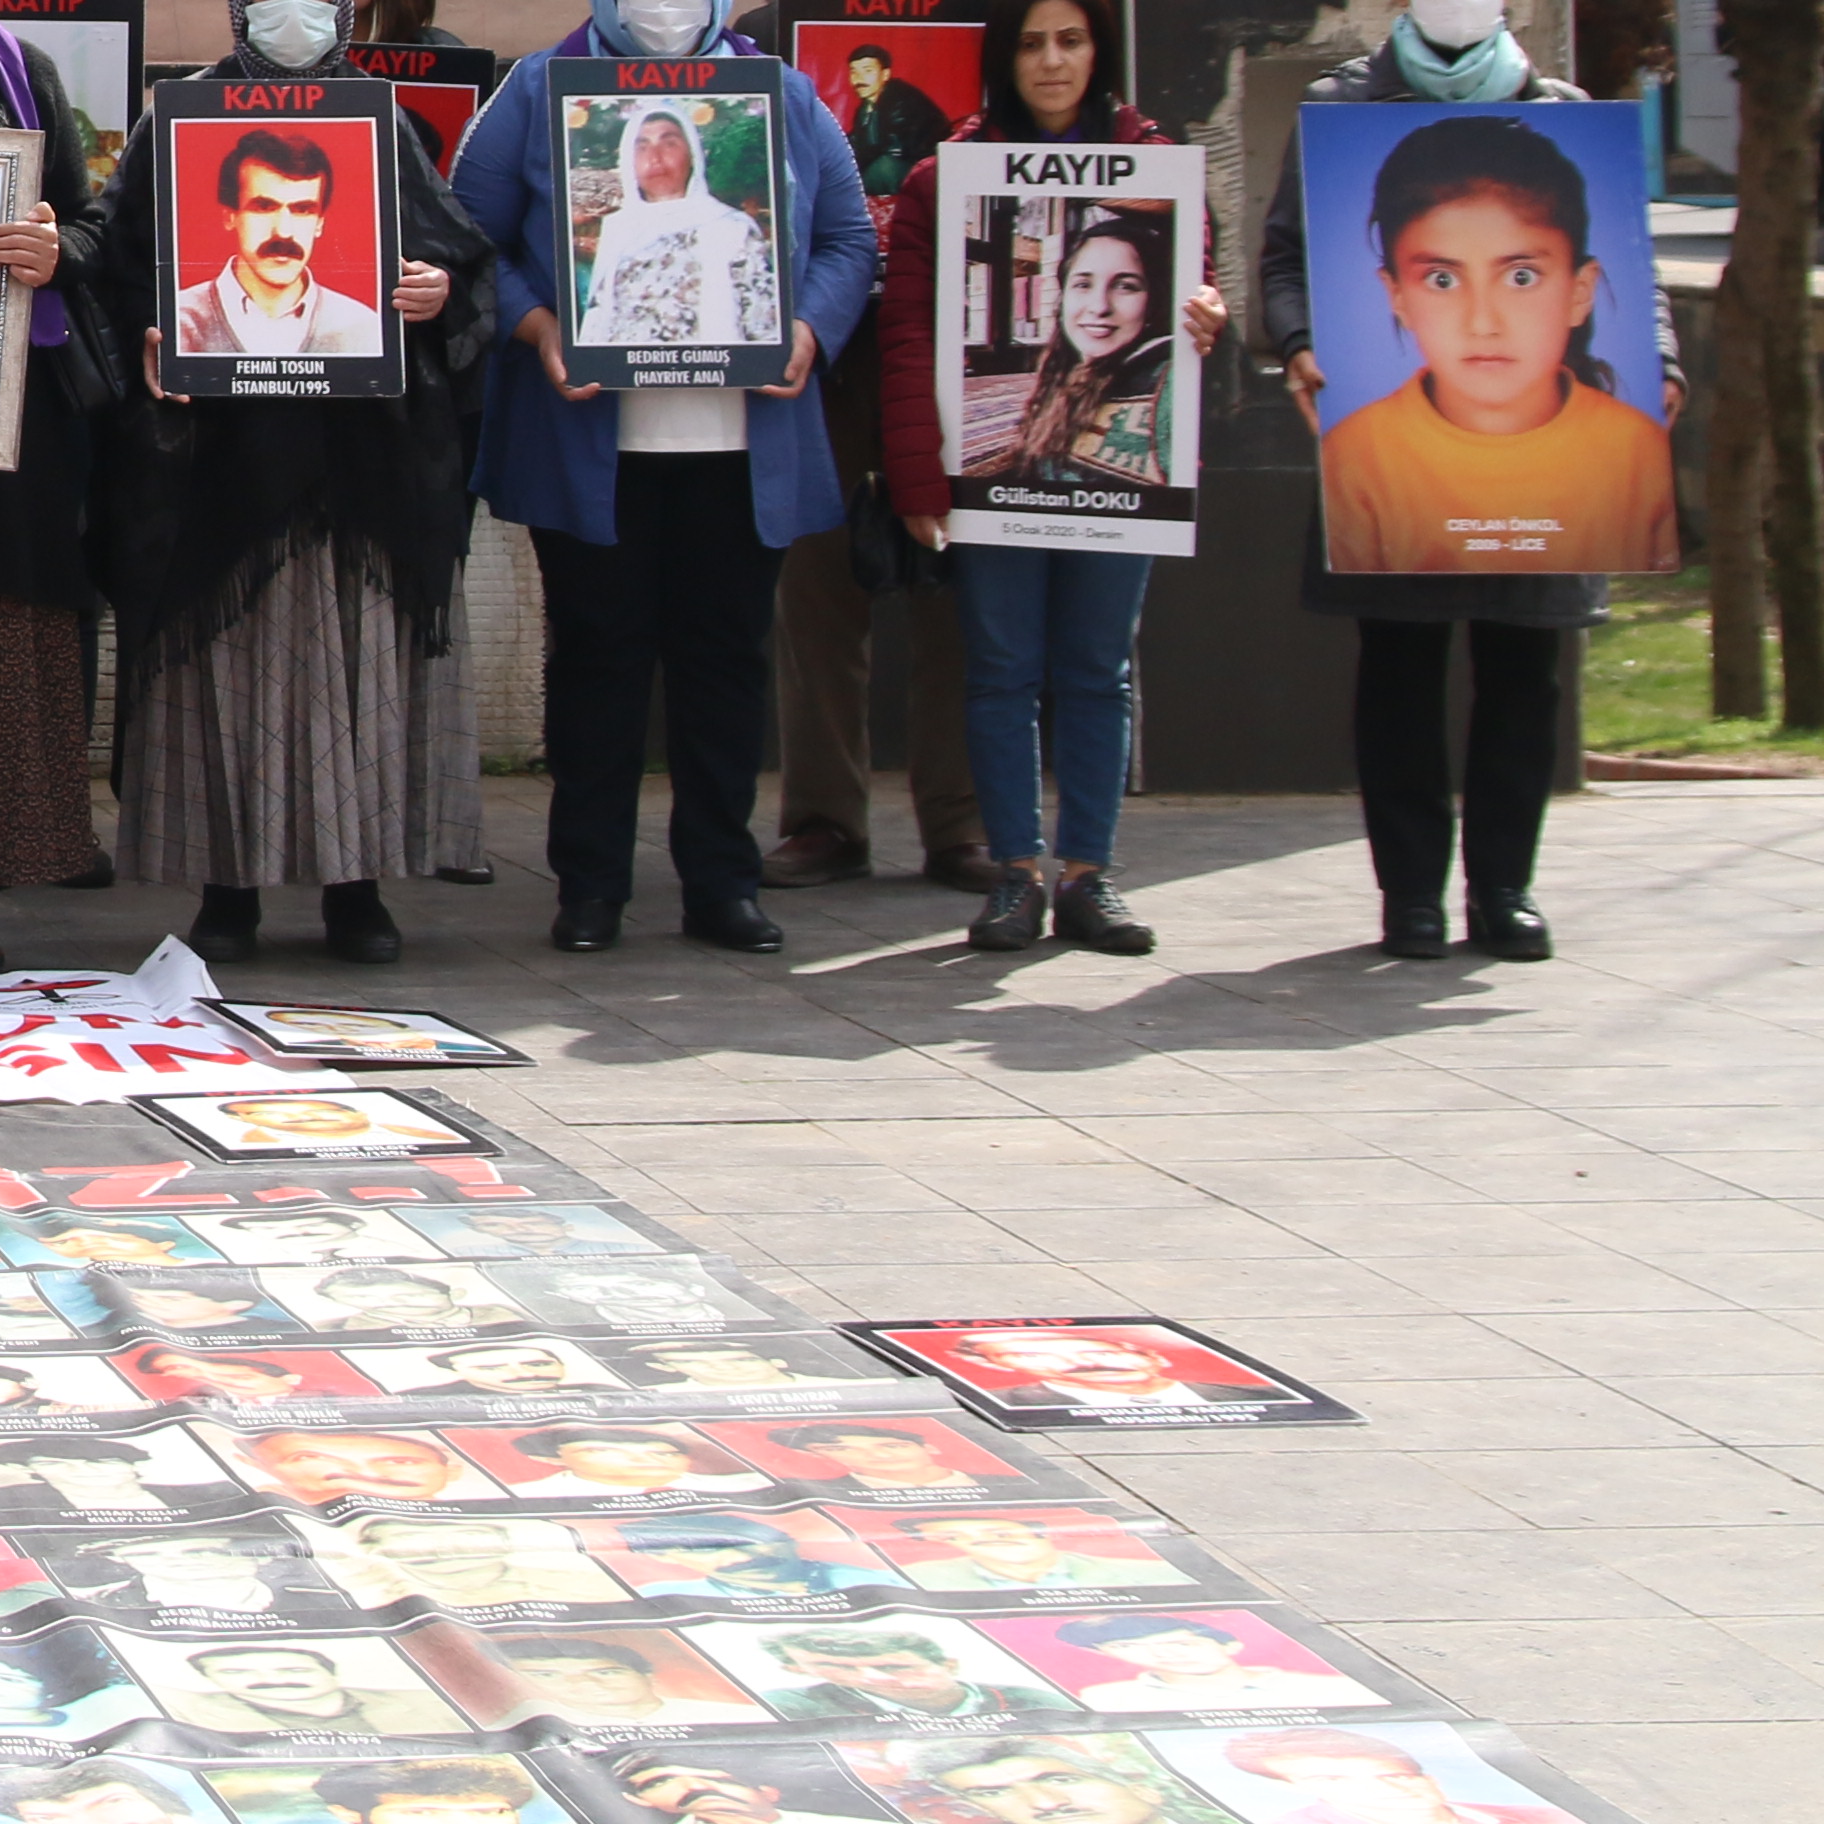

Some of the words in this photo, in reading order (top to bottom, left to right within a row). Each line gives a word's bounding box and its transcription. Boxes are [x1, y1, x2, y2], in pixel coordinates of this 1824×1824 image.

[615, 62, 716, 89] KAYIP
[224, 85, 326, 111] KAYIP
[1005, 152, 1137, 186] KAYIP
[236, 357, 278, 375] FEHMİ
[281, 360, 325, 375] TOSUN
[627, 347, 680, 365] BEDRİYE
[682, 346, 731, 367] GÜMÜŞ
[231, 378, 331, 396] İSTANBUL/1995
[634, 367, 692, 387] (HAYRİYE
[693, 368, 725, 387] ANA)
[990, 485, 1070, 508] Gülistan
[1072, 489, 1141, 511] DOKU
[1002, 522, 1010, 534] 5
[1012, 522, 1041, 536] Ocak
[1043, 524, 1075, 537] 2020
